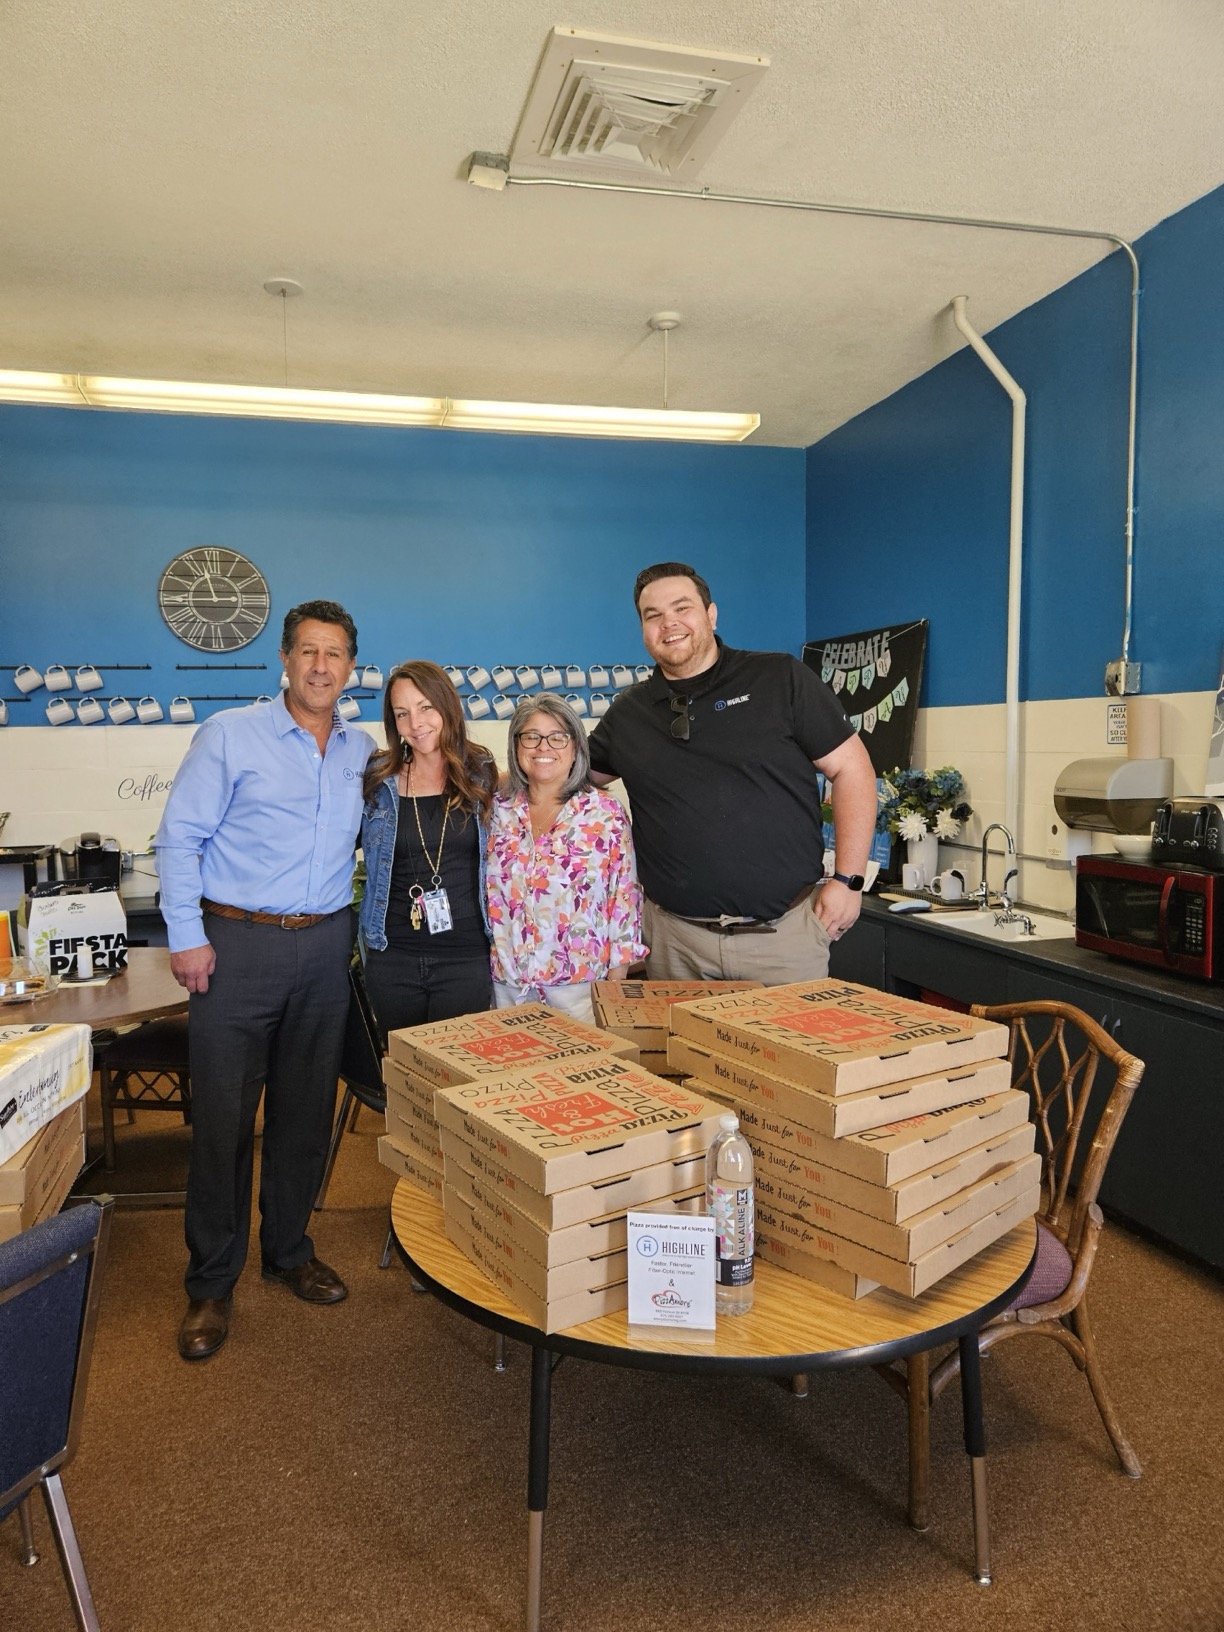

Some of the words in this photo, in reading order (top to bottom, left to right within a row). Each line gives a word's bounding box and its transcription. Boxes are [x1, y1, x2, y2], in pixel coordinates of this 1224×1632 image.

[822, 631, 890, 669] CELEBRATE
[118, 774, 173, 801] Coffee
[49, 933, 127, 955] FIESTA
[696, 996, 772, 1012] Pizza
[799, 987, 865, 1002] Pizza
[501, 1010, 554, 1027] Pizza
[719, 1005, 790, 1020] Pizza
[837, 999, 933, 1029] Pizza
[410, 1022, 475, 1037] Pizza
[423, 1030, 487, 1045] Pizza
[526, 1022, 586, 1050] Pizza
[744, 1020, 854, 1055] PIZZA
[890, 1024, 961, 1041] Pizza
[716, 1027, 732, 1044] Made
[735, 1036, 750, 1051] Just
[750, 1042, 760, 1055] for
[438, 1044, 504, 1074] PIZZA
[544, 1044, 601, 1061] Pizza
[554, 1058, 611, 1075] Pizza
[565, 1064, 630, 1084] Pizza
[458, 1078, 536, 1098] Pizza
[531, 1072, 574, 1096] PIZZA
[714, 1063, 730, 1080] Made
[733, 1072, 748, 1088] Just
[748, 1079, 759, 1092] for
[475, 1090, 549, 1109] Pizza
[596, 1079, 669, 1115] Pizza
[617, 1072, 705, 1115] PIZZA
[525, 1095, 601, 1119] Fresh
[562, 1108, 580, 1118] &
[493, 1108, 572, 1149] PIZZA
[619, 1110, 688, 1130] Pizza
[740, 1108, 758, 1125] Made
[761, 1118, 781, 1135] Just
[780, 1125, 794, 1139] for
[768, 1152, 788, 1169] Just
[788, 1160, 801, 1173] for
[755, 1177, 774, 1195] Made
[777, 1187, 798, 1204] Just
[798, 1196, 811, 1209] for
[757, 1208, 776, 1227] Made
[780, 1220, 800, 1237] Just
[800, 1229, 814, 1243] for
[662, 1241, 706, 1256] HIGHLINE
[668, 1279, 675, 1287] &
